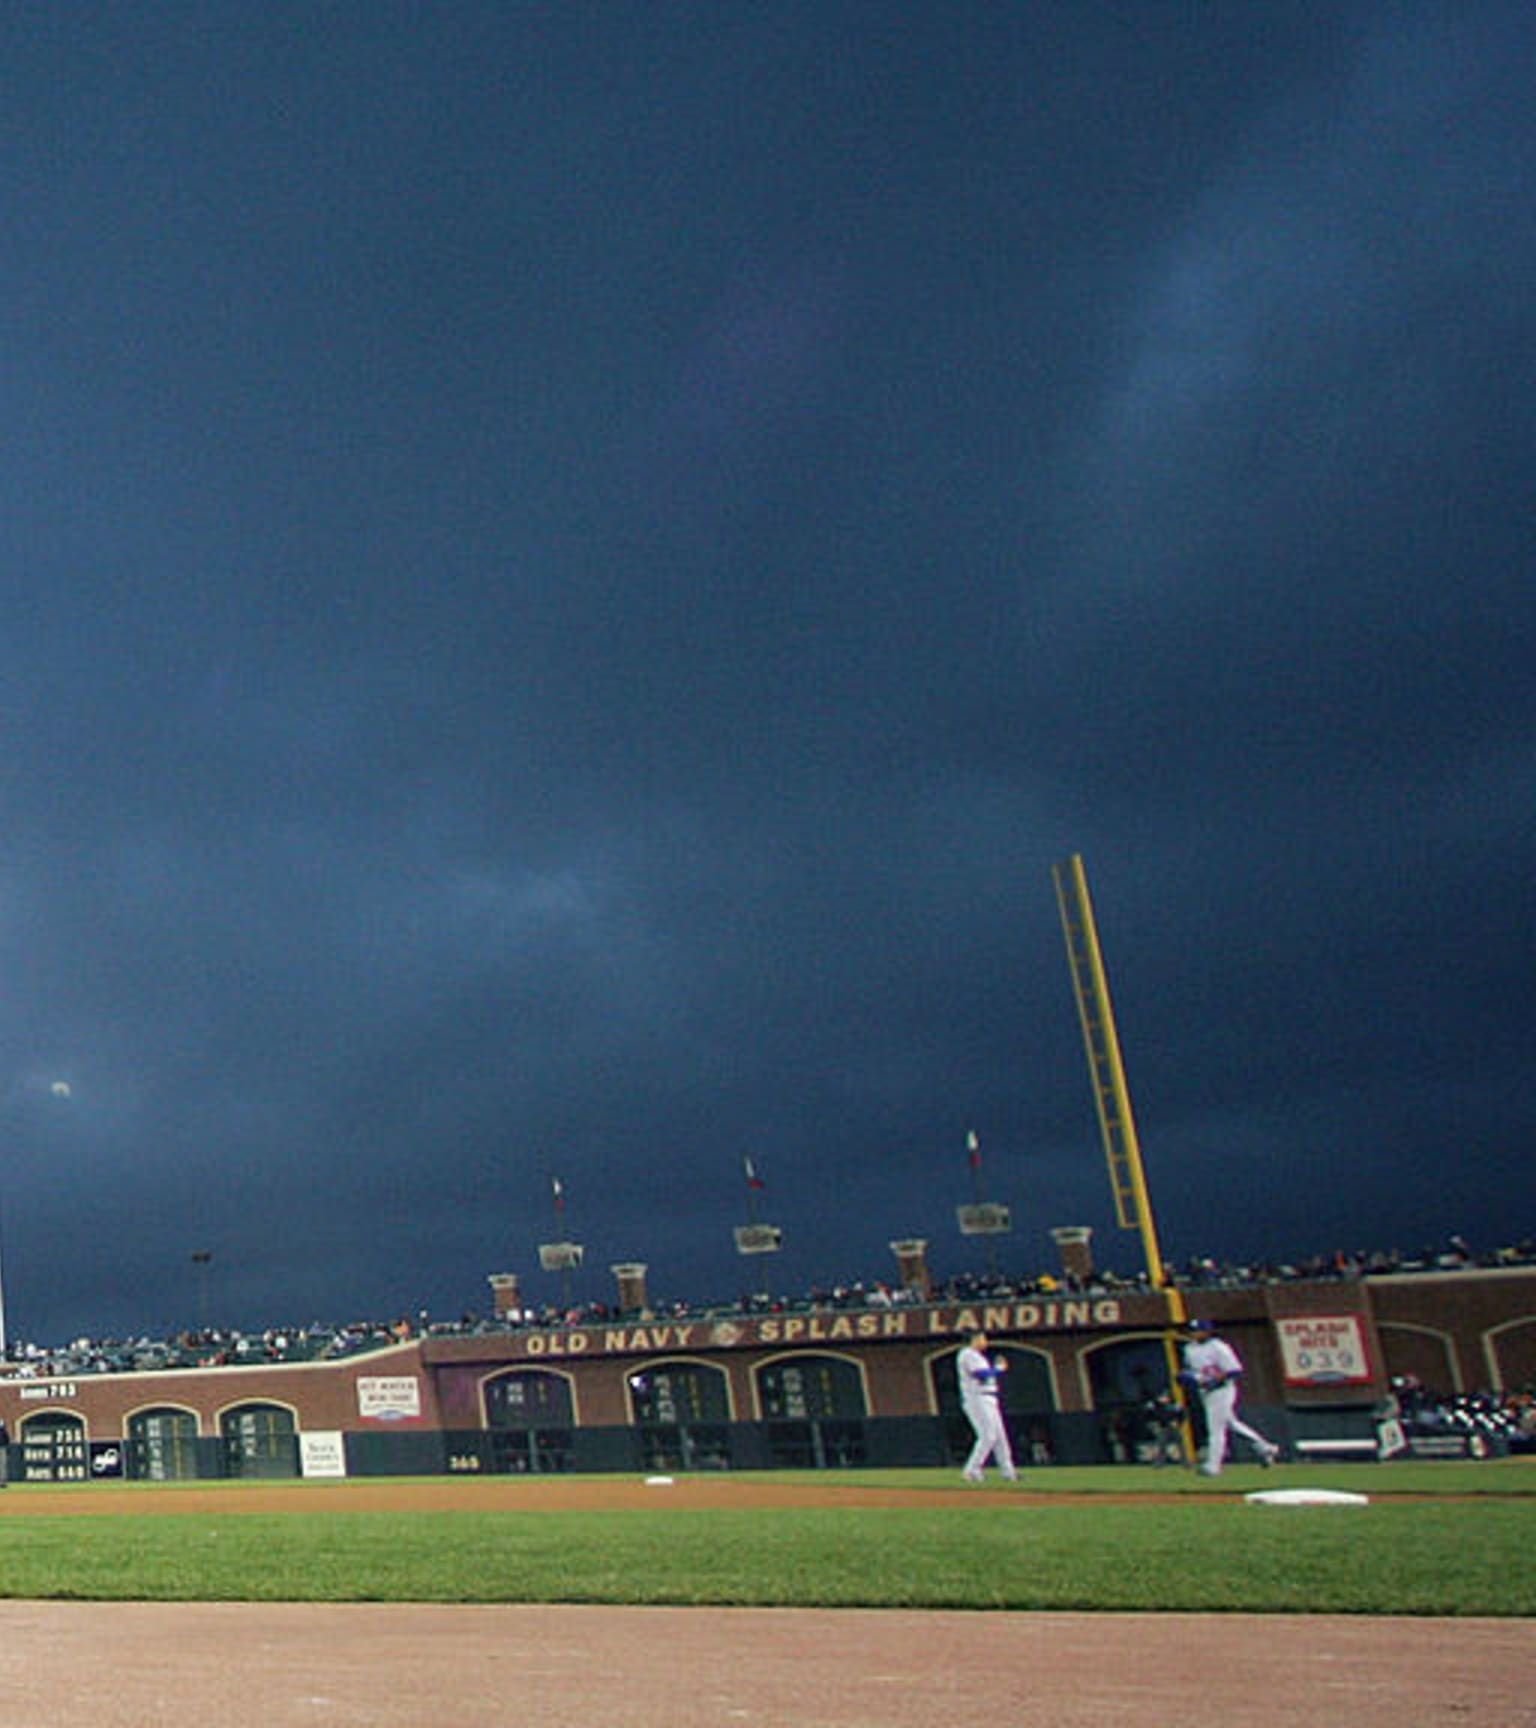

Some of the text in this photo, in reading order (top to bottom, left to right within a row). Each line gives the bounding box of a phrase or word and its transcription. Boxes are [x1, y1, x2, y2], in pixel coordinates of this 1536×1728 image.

[527, 1300, 1120, 1354] OLD NAVY SPLASH LANDING
